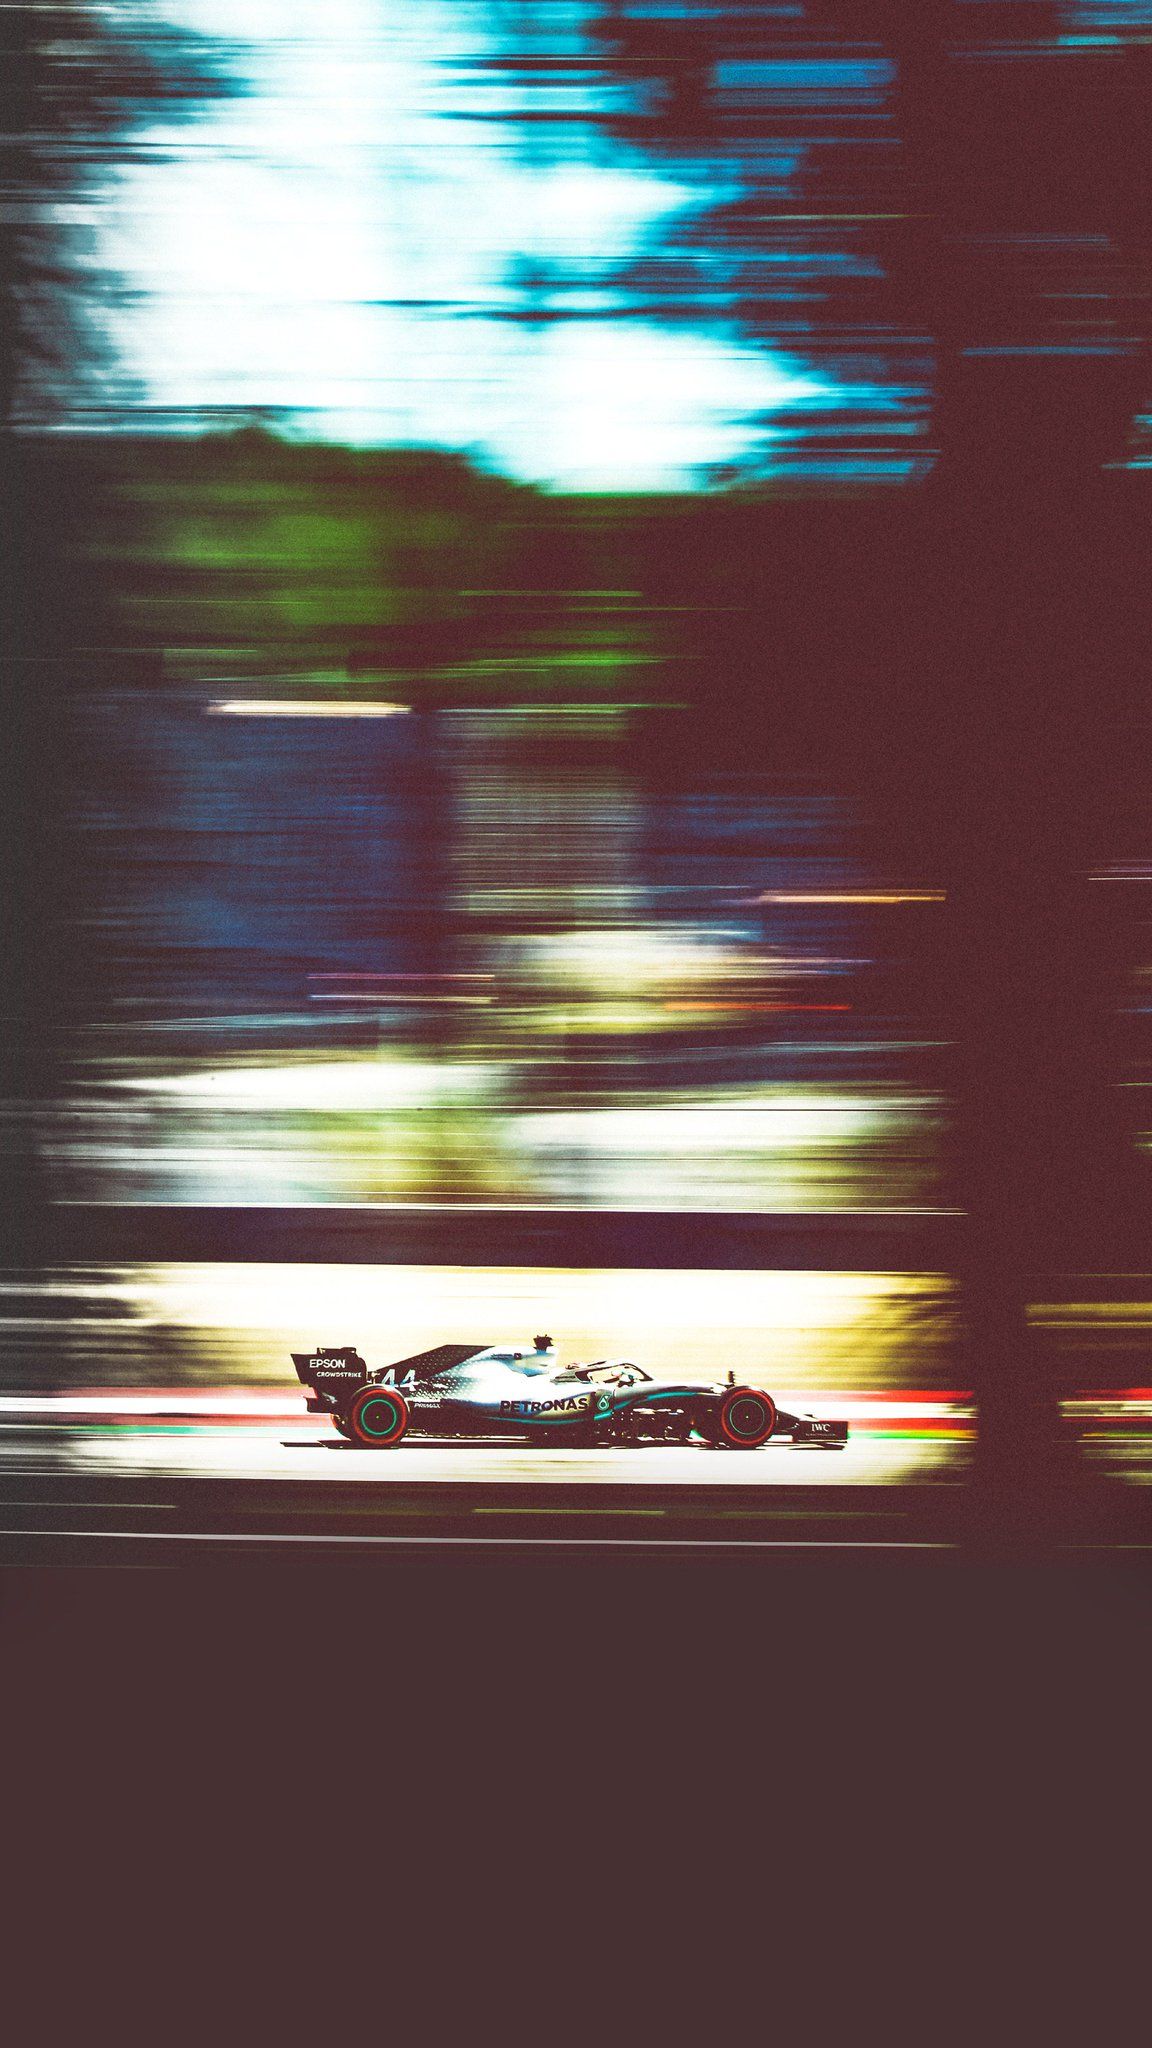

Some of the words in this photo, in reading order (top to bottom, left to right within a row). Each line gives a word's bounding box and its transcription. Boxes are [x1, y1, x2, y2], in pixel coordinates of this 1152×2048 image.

[309, 1358, 346, 1369] EPSON
[381, 1368, 420, 1392] 44
[500, 1398, 588, 1413] PETRONAS
[811, 1423, 831, 1432] IWC
